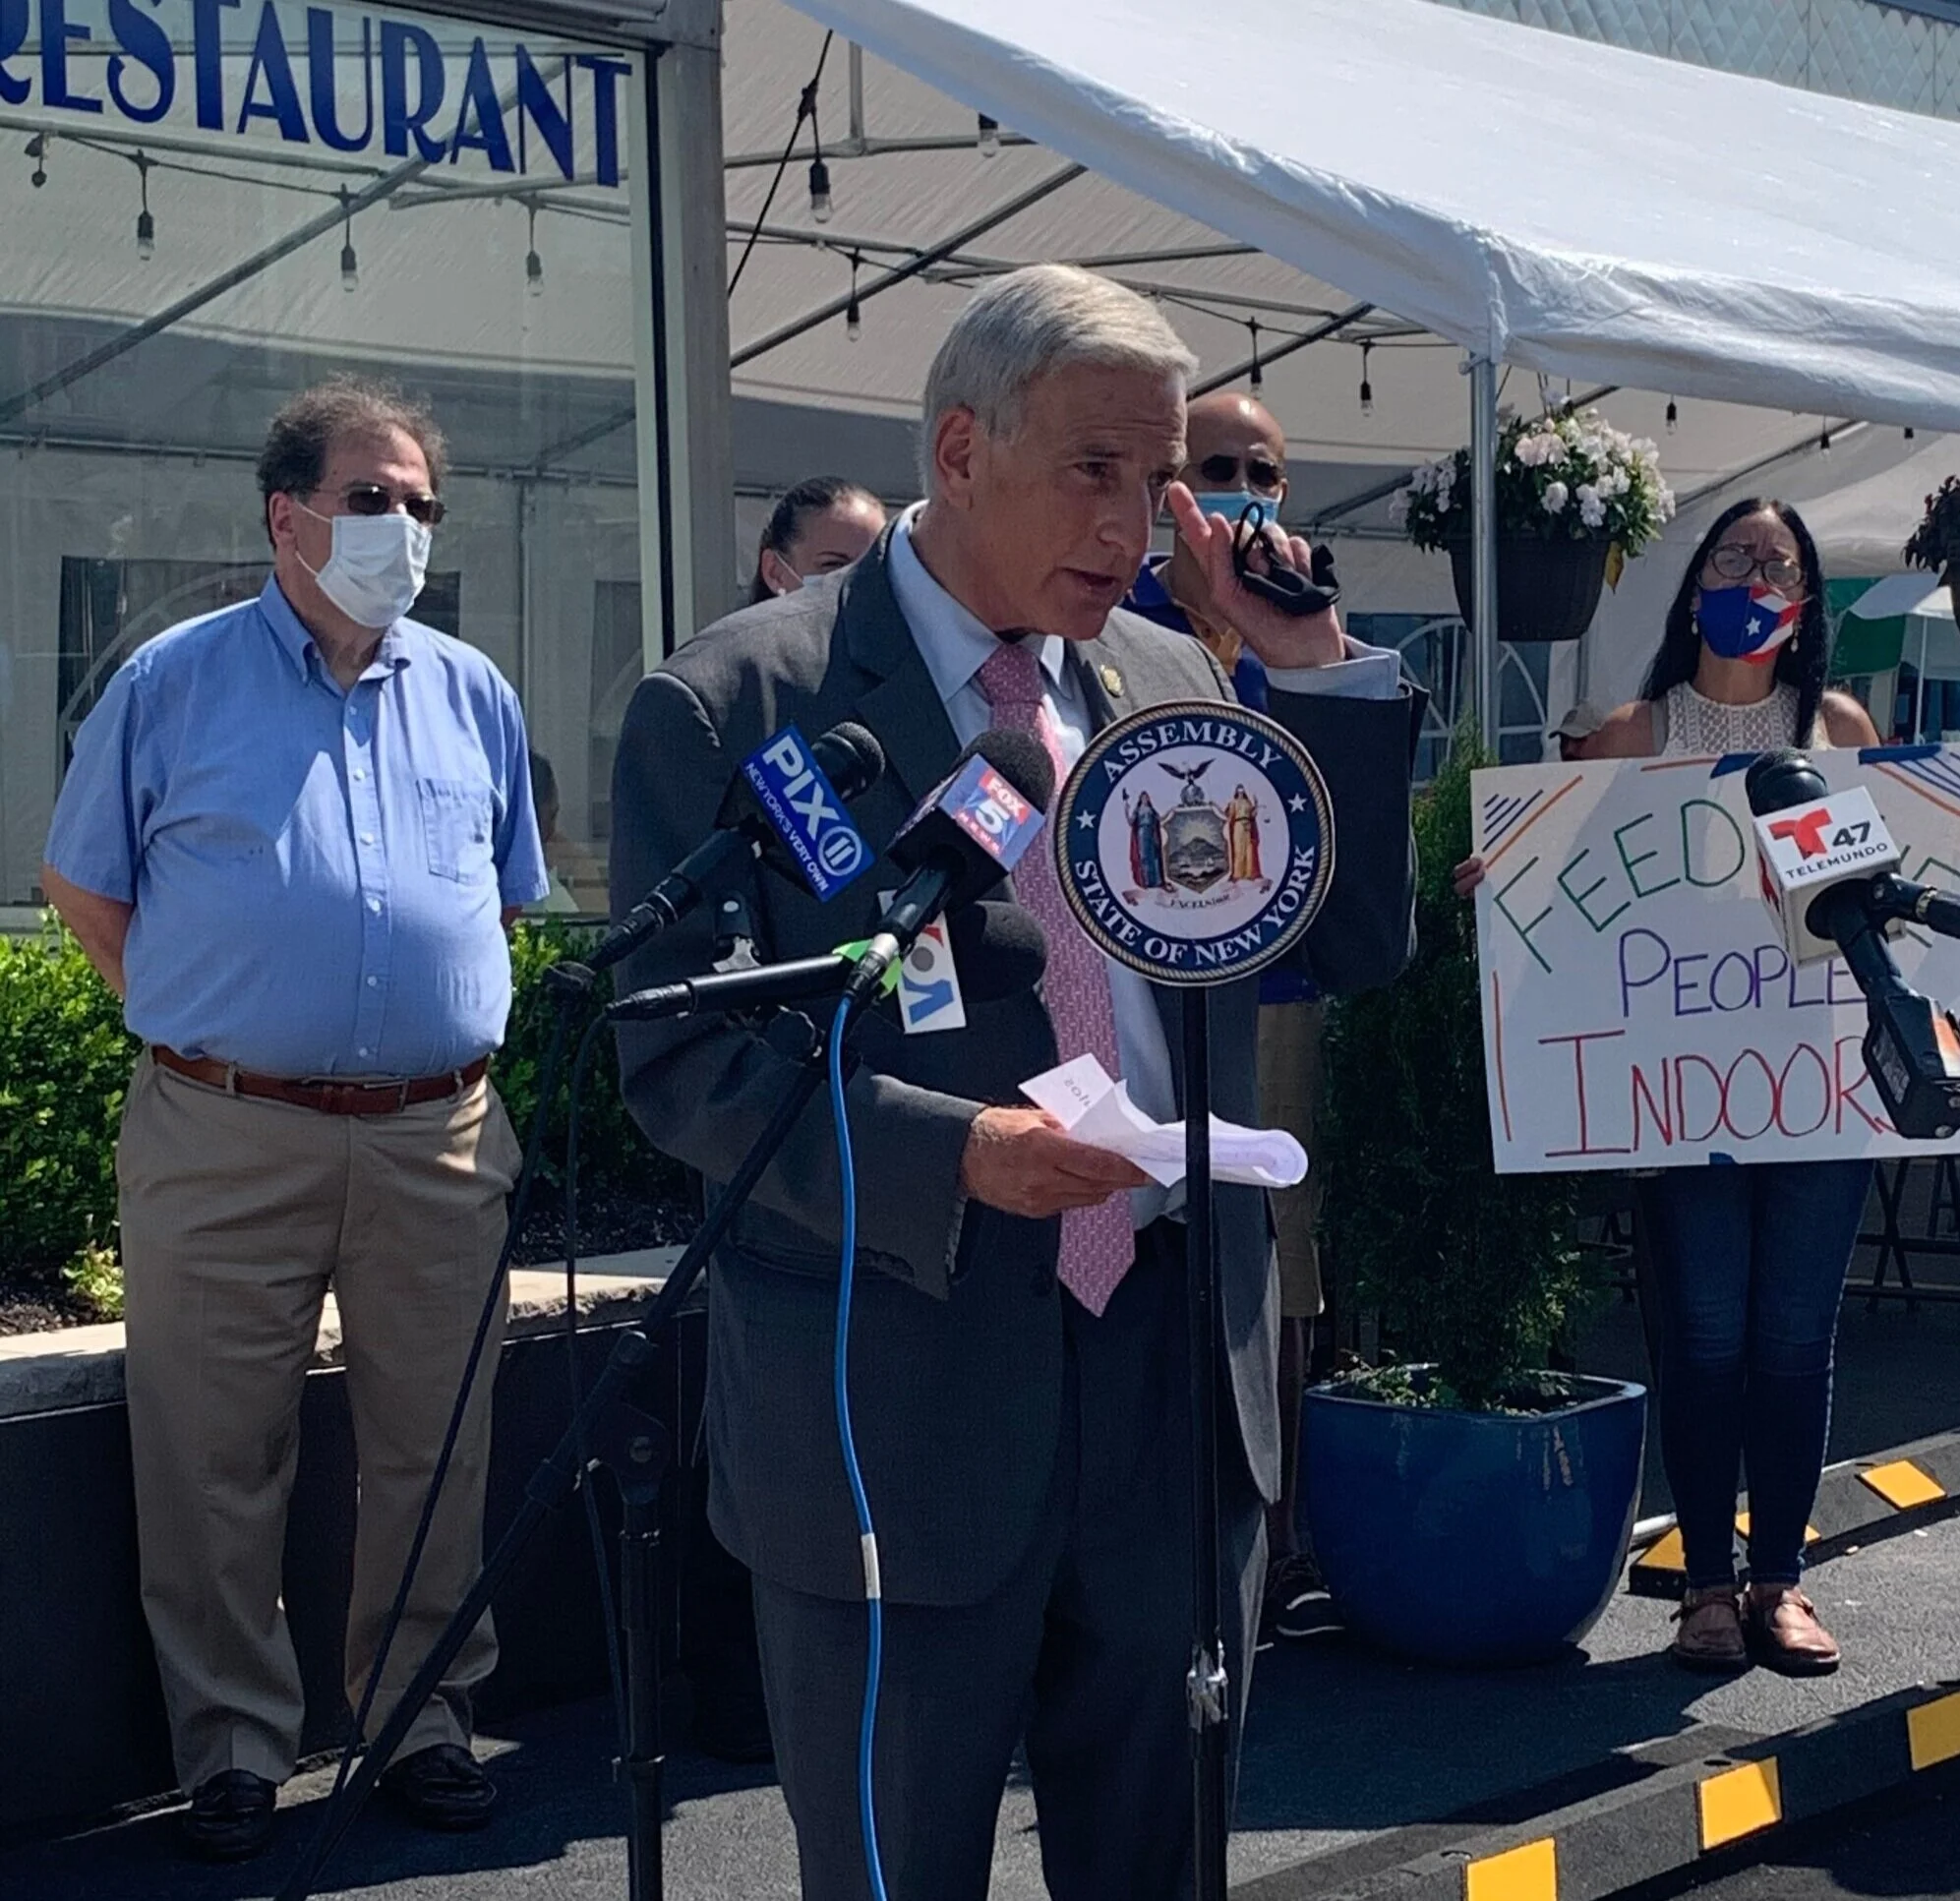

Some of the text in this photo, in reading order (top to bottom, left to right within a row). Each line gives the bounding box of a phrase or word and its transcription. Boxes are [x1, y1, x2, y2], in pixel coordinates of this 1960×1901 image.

[762, 735, 841, 842] PIX
[986, 776, 1028, 817] FOX
[1101, 721, 1283, 784] ASSEMBLY
[744, 761, 830, 892] NEW YORK'S VERY OWN
[975, 798, 1011, 835] 5
[1785, 842, 1888, 879] TELEMUNDO
[1831, 820, 1871, 847] 47
[1075, 846, 1315, 965] STATE OF NEW YORK
[1492, 798, 1746, 974] FEED
[1618, 927, 1868, 1018] PEOPLE
[1537, 1029, 1900, 1158] INDOOR
